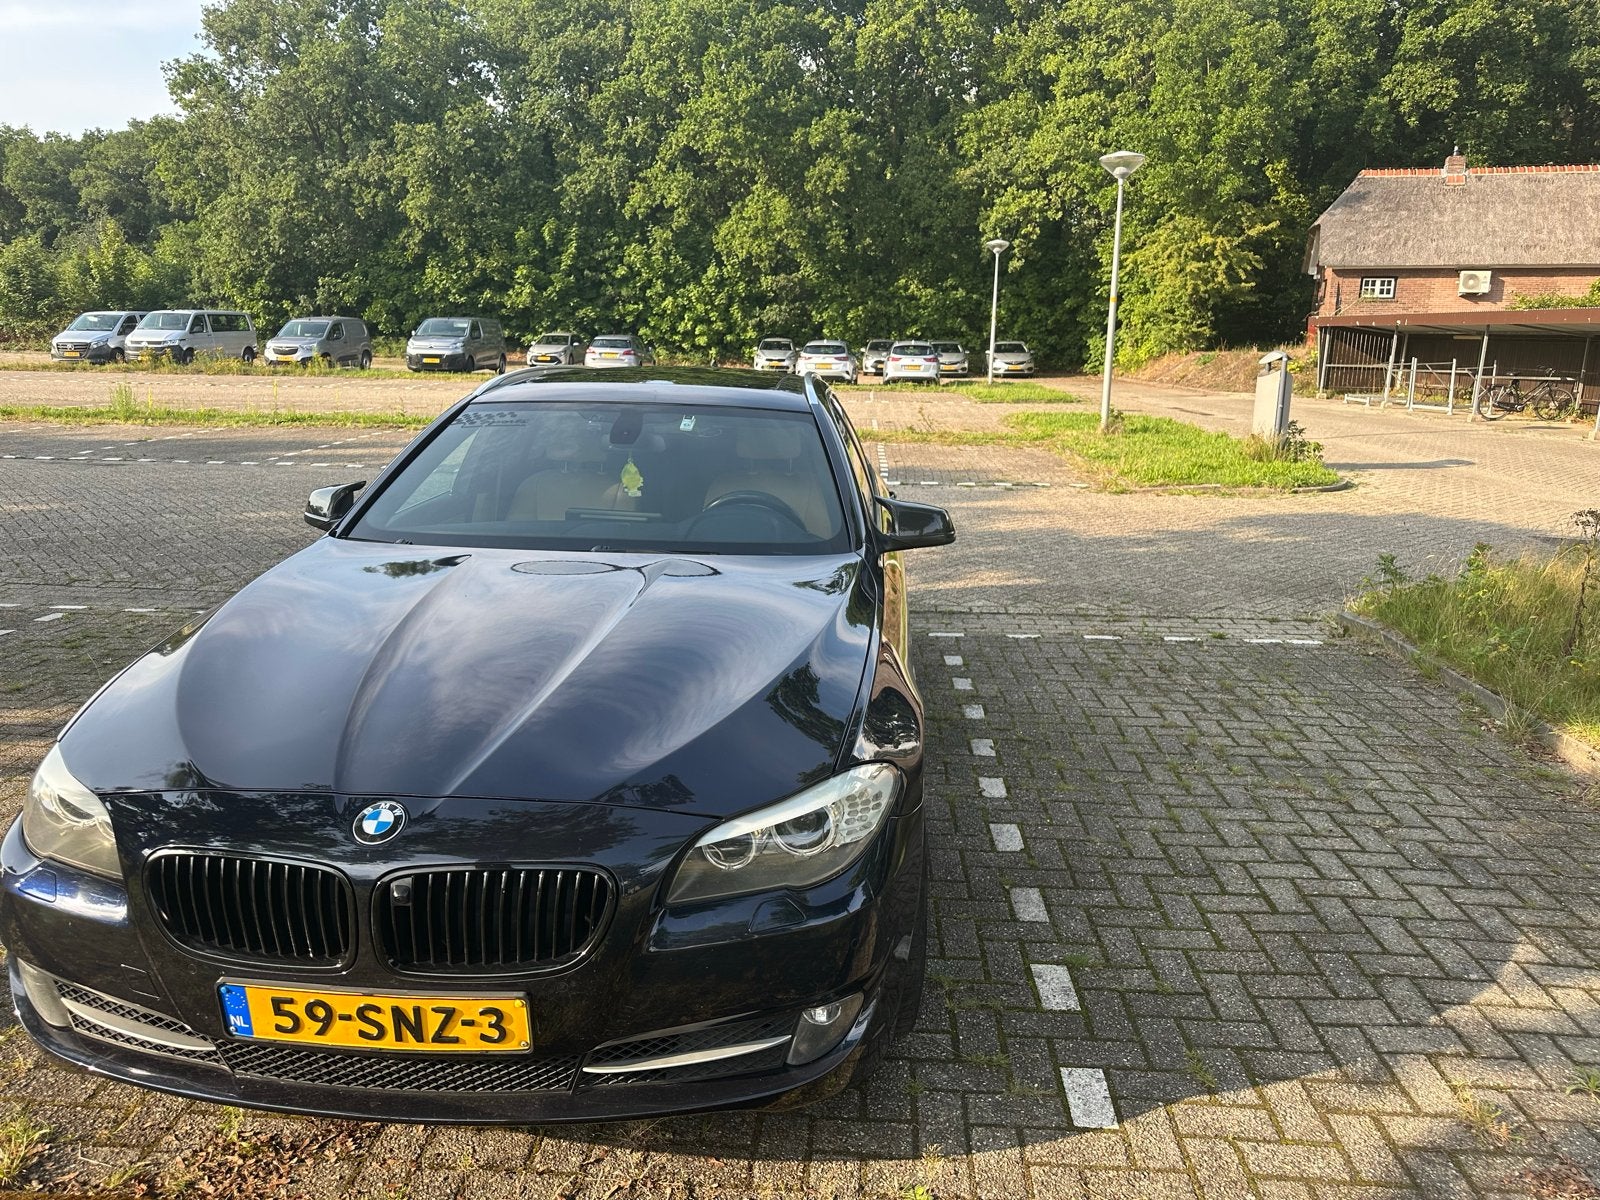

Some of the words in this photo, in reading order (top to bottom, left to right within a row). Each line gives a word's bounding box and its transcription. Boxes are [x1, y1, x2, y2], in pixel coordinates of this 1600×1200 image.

[363, 802, 403, 816] BMW
[229, 1013, 250, 1028] NL
[270, 995, 508, 1044] 59-SNZ-3
